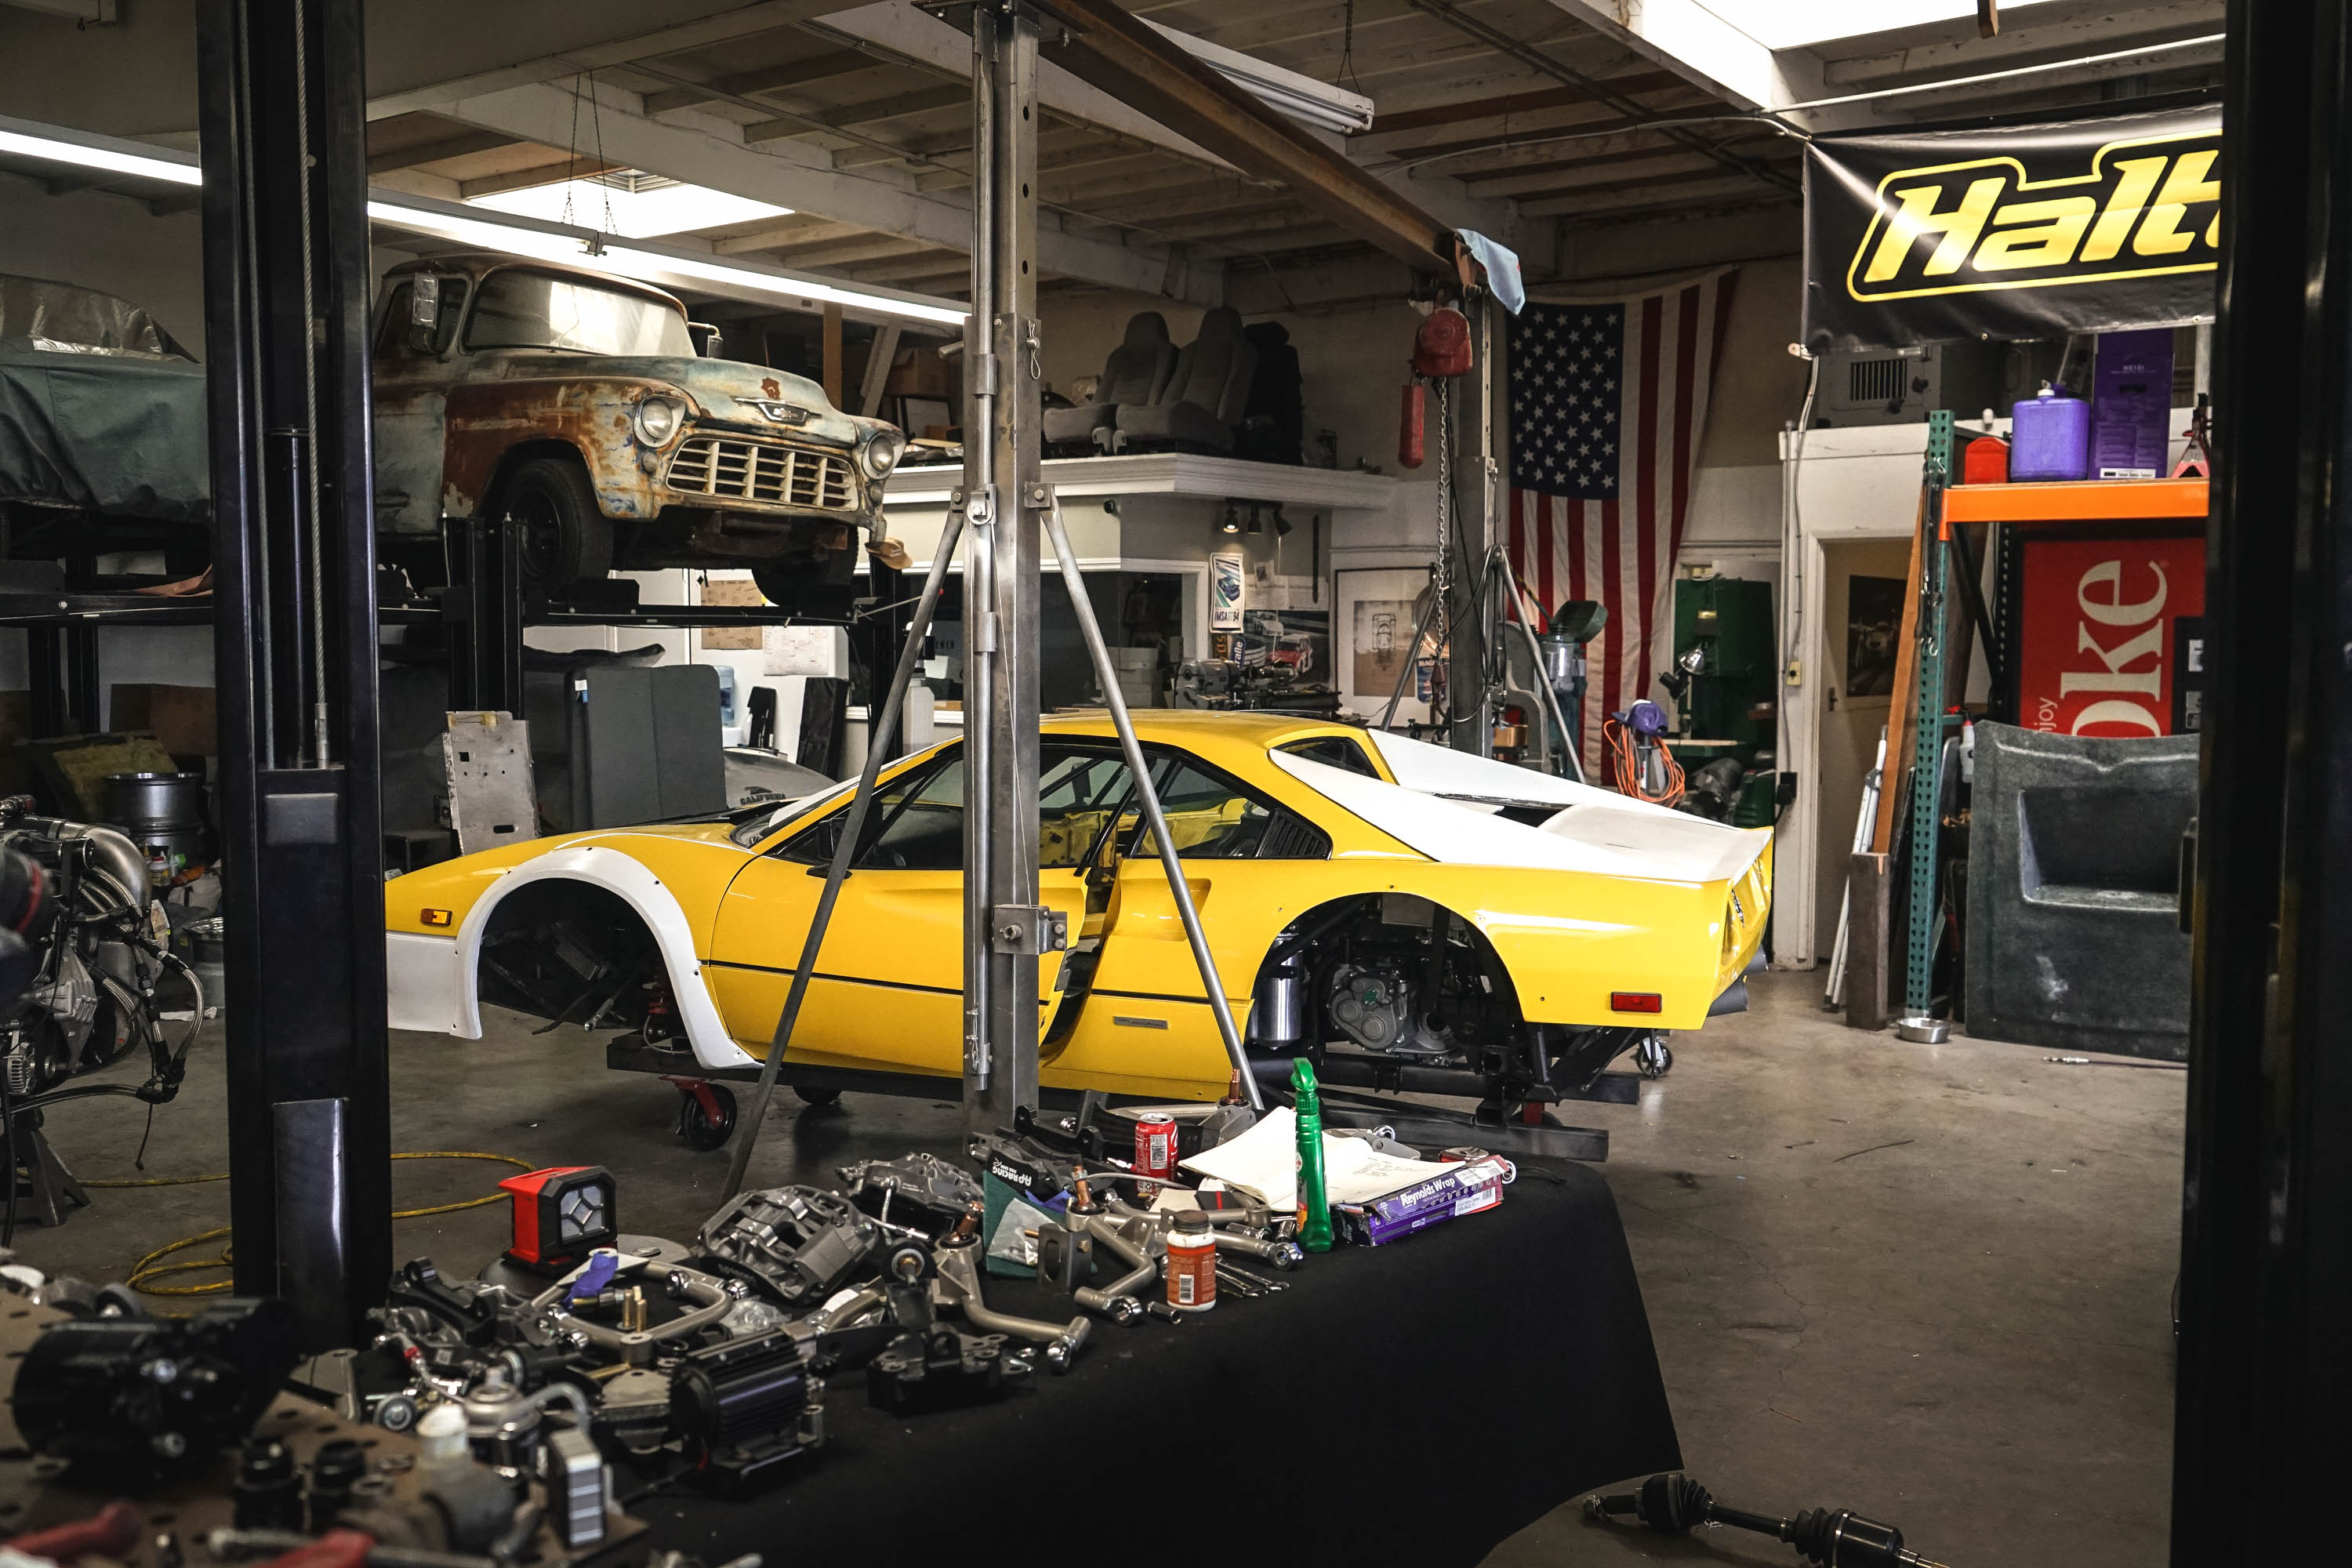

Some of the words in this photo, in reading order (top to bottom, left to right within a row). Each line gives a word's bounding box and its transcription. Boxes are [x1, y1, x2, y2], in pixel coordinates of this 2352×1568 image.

[1864, 149, 2219, 283] Halt
[992, 1166, 1018, 1181] RACING
[1018, 1174, 1032, 1186] AP
[1400, 1184, 1435, 1207] Reynolds
[1433, 1177, 1456, 1192] Wrap
